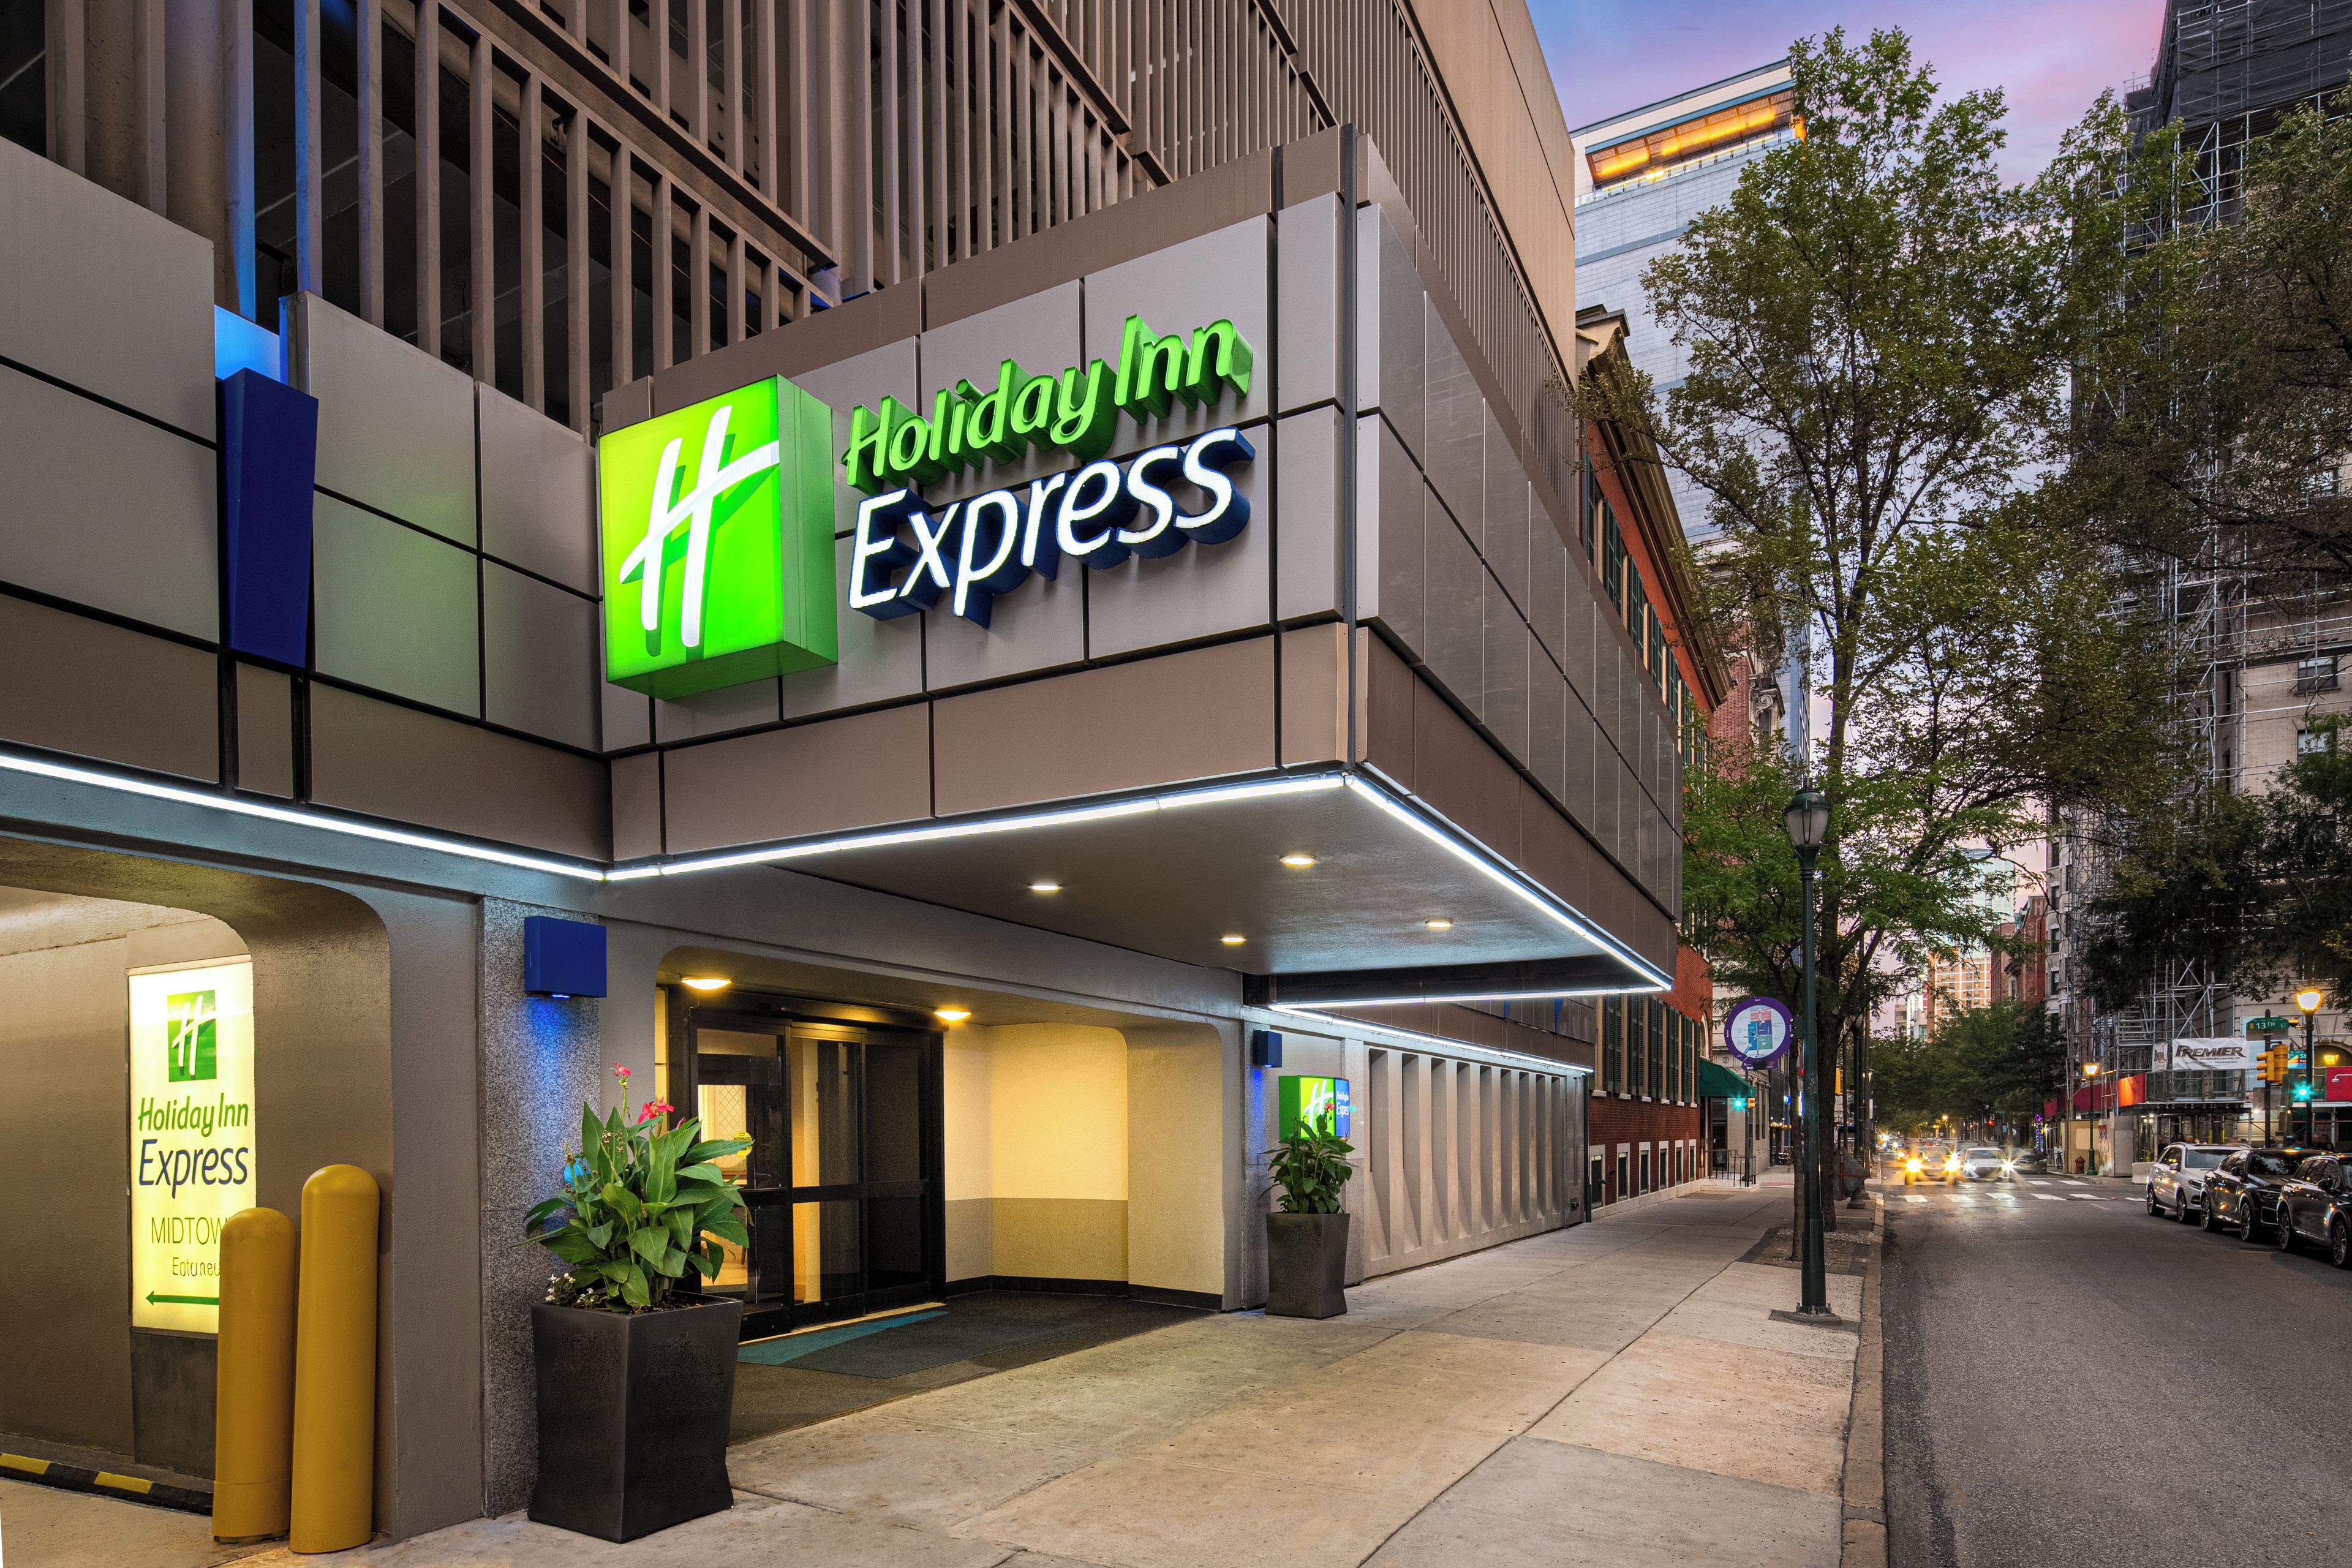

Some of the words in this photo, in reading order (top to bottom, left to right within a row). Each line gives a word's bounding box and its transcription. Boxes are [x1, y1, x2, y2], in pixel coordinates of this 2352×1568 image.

[842, 358, 1116, 490] Holiday
[1114, 314, 1253, 424] Inn
[848, 427, 1255, 626] Express
[2174, 1045, 2247, 1060] PREMIER
[138, 1095, 216, 1137] Holiday
[217, 1092, 249, 1128] Inn
[139, 1138, 249, 1199] Express
[151, 1216, 230, 1245] MIDTOW
